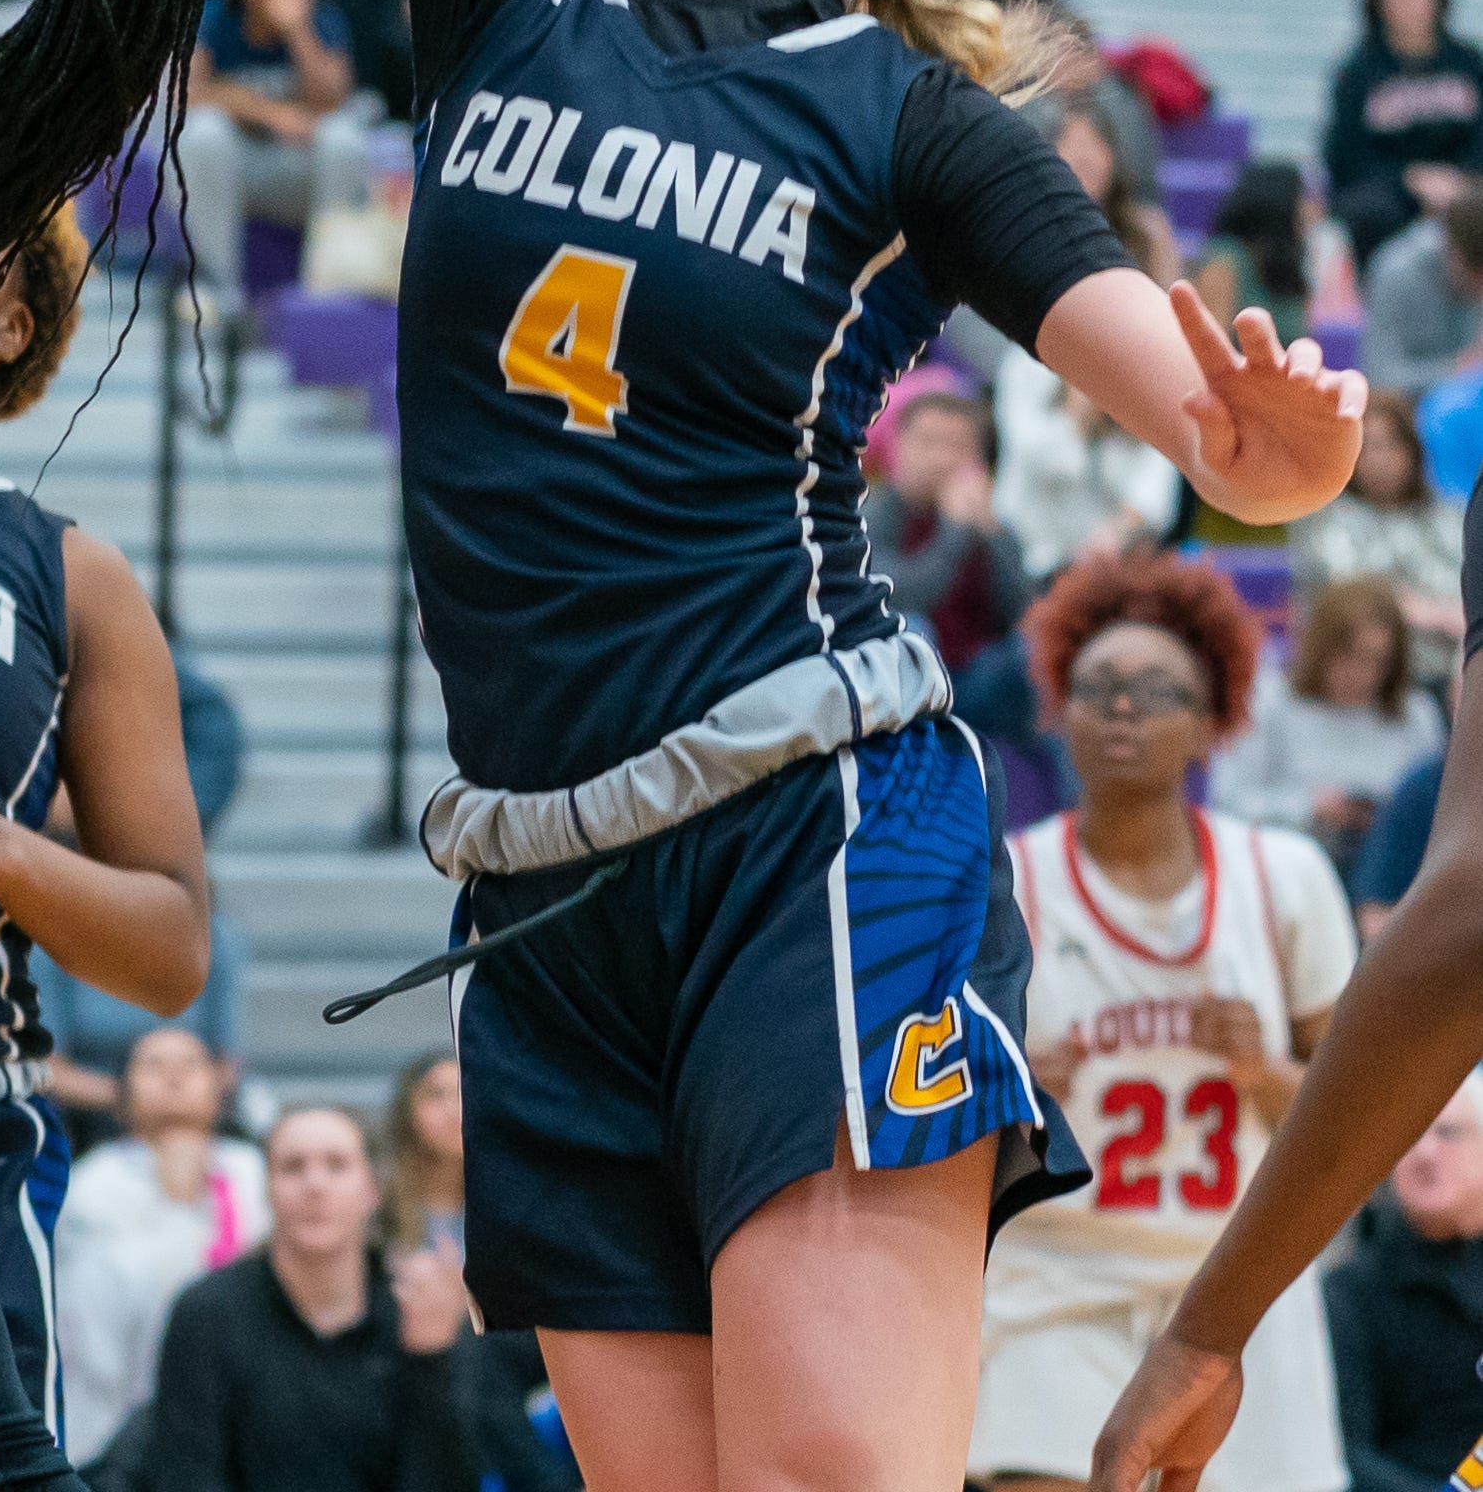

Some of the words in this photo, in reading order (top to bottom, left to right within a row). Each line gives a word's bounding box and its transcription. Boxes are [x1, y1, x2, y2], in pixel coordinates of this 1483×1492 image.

[441, 90, 816, 284] COLONIA
[498, 243, 637, 438] 4
[885, 995, 973, 1116] C
[1096, 1078, 1238, 1210] 23
